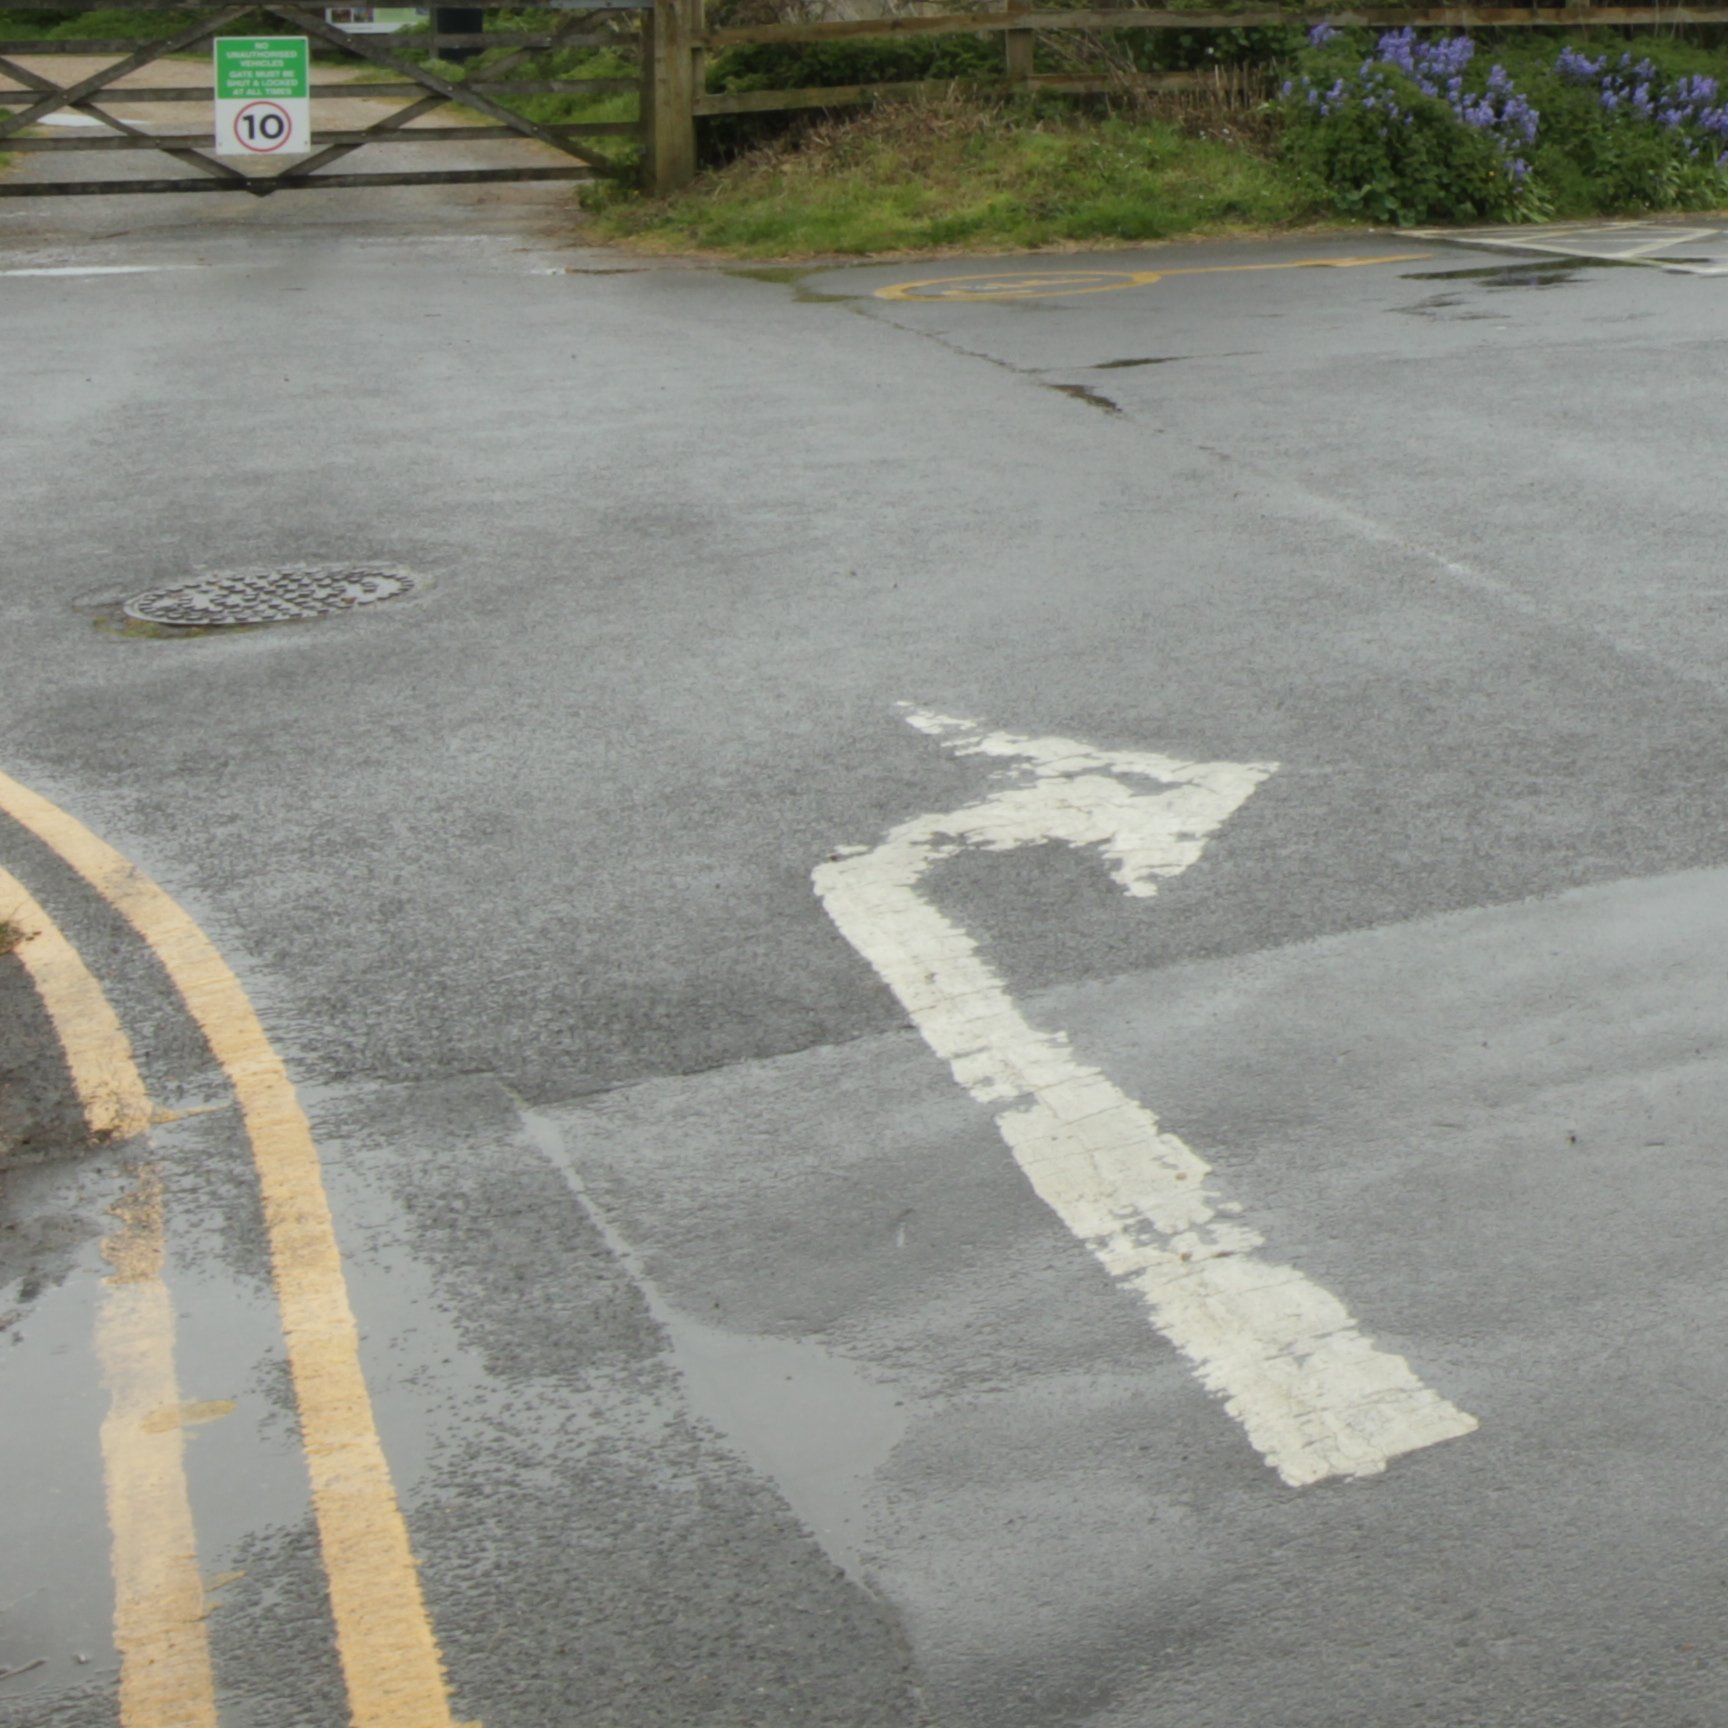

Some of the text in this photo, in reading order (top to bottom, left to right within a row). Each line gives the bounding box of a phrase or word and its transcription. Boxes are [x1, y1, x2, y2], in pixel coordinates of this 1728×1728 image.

[254, 42, 269, 50] NO
[226, 50, 298, 59] UNAUTHORISED
[239, 59, 284, 67] VEHICLES
[229, 70, 295, 78] GATE MUST BE
[226, 79, 251, 87] SHUT
[261, 79, 298, 87] LOCKED
[232, 87, 292, 96] AT ALL TIMES
[242, 114, 284, 140] 10
